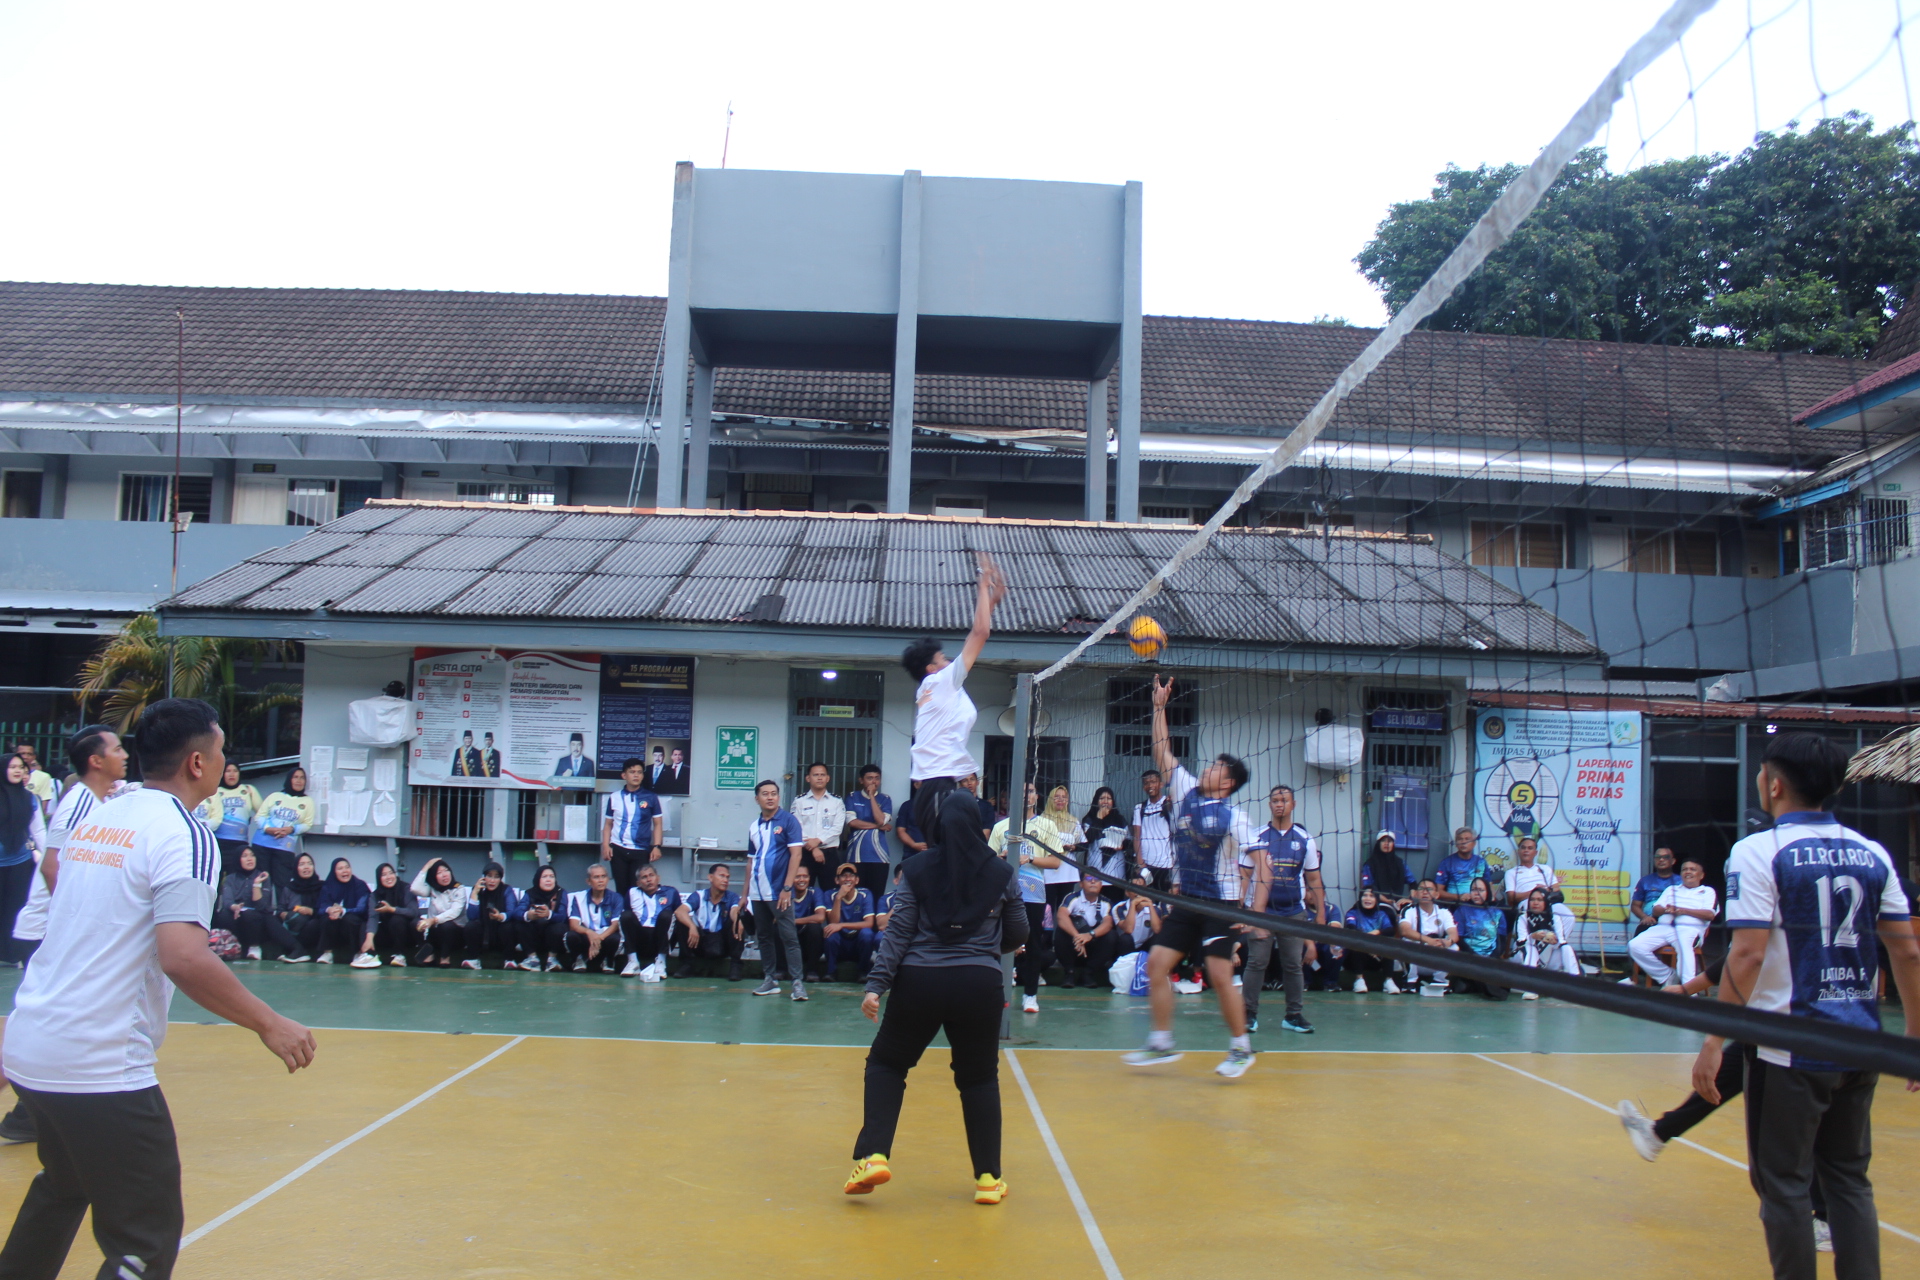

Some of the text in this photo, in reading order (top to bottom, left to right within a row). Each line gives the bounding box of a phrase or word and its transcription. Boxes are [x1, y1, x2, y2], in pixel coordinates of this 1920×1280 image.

[432, 664, 482, 672] ASTA CITA
[639, 664, 672, 673] PROGRAM
[1387, 714, 1399, 725] SEL
[1577, 759, 1634, 769] LAPERANG
[1576, 770, 1625, 784] PRIMA
[1517, 790, 1529, 802] 5
[1575, 805, 1606, 815] Bersih
[71, 824, 136, 849] KANWIL
[96, 851, 125, 869] SUMSEL
[1815, 874, 1864, 948] 12
